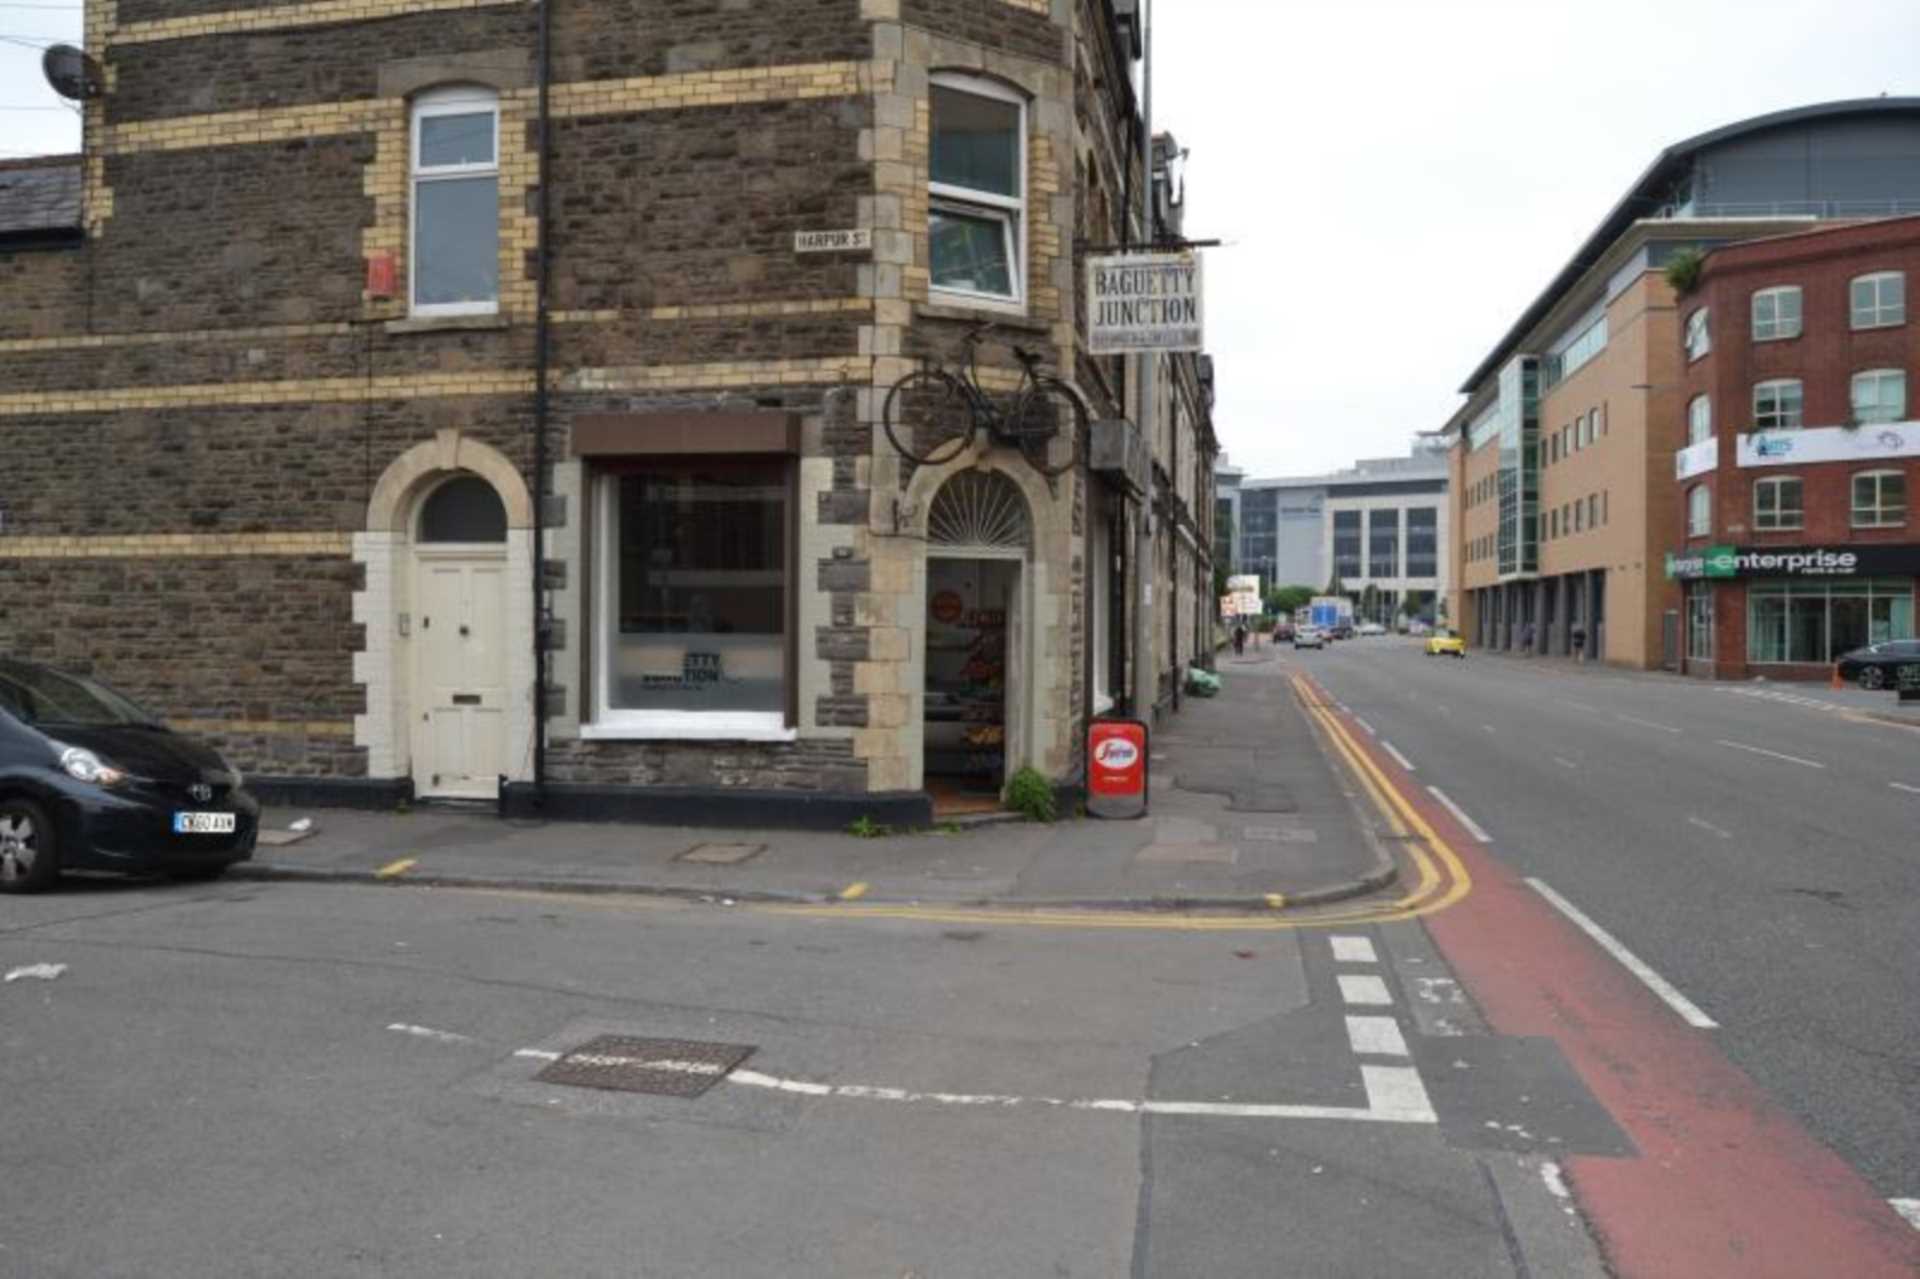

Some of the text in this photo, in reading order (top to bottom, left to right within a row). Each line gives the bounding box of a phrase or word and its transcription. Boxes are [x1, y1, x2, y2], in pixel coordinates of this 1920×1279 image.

[798, 232, 849, 249] HARPUR
[1095, 267, 1195, 296] BAGUETTY
[1095, 296, 1196, 327] JUNCTION
[1715, 550, 1857, 571] enterprise
